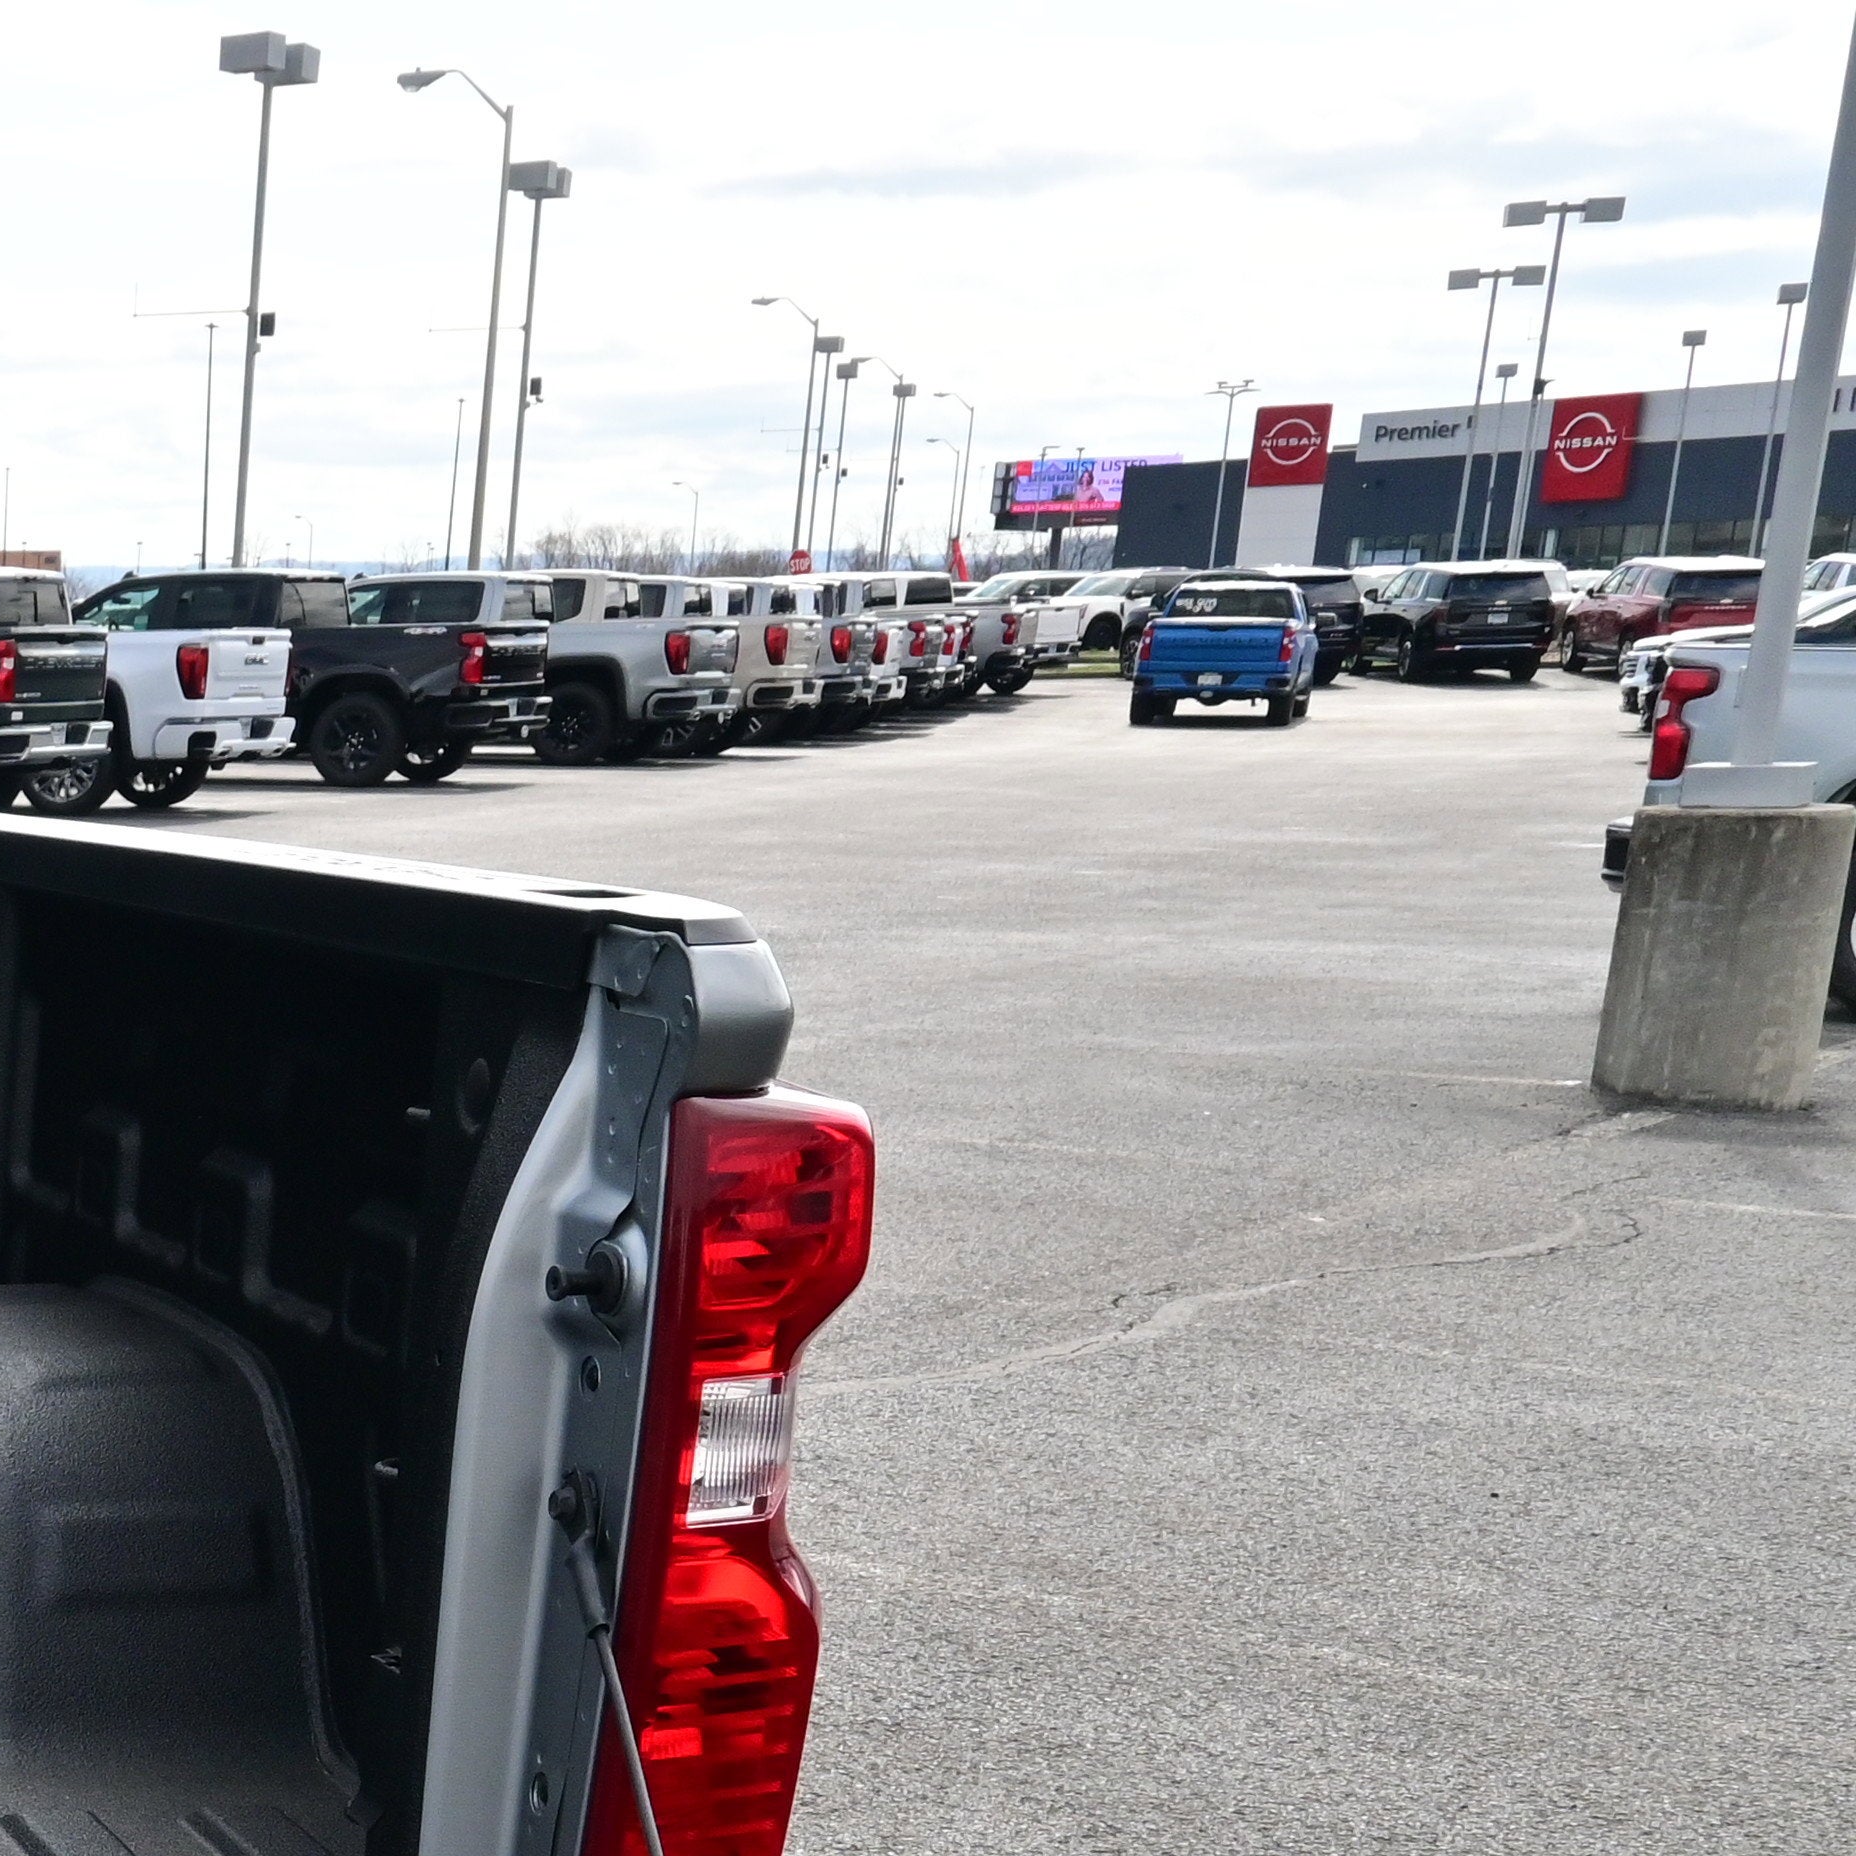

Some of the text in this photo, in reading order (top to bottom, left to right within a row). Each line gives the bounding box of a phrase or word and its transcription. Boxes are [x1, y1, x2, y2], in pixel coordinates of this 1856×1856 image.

[1374, 420, 1461, 443] Premier
[1261, 436, 1322, 448] NISSAN
[1554, 435, 1617, 450] NISSAN
[1064, 461, 1096, 473] JUST
[789, 557, 811, 572] STOP
